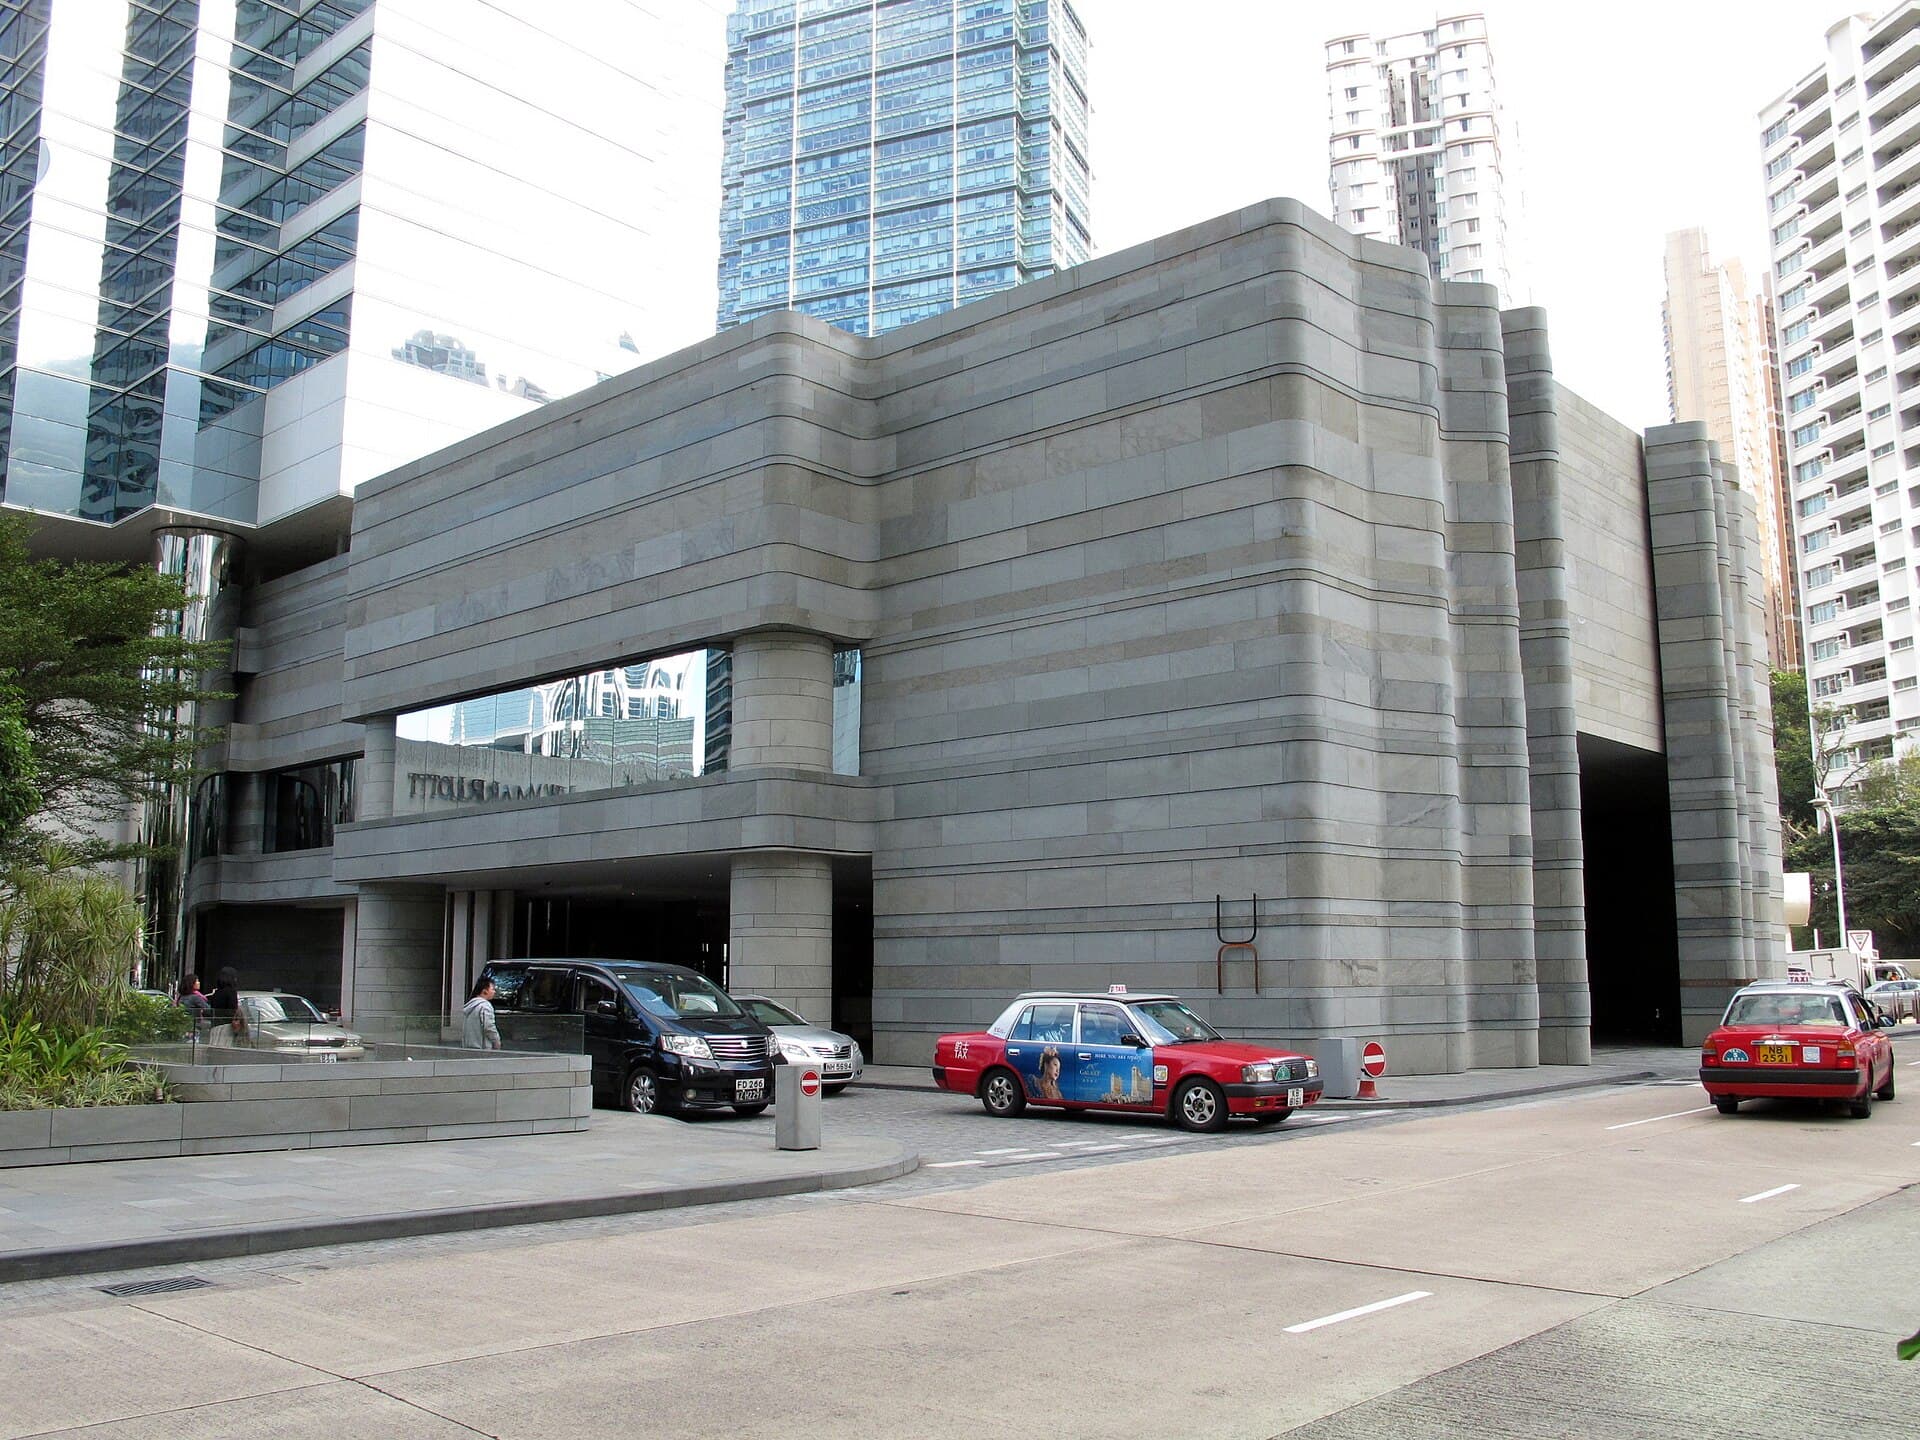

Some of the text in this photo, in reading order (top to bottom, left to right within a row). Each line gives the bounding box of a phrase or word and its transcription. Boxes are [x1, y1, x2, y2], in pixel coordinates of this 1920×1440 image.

[1769, 1046, 1783, 1054] NB
[1762, 1054, 1788, 1063] 2521
[737, 1079, 763, 1089] FD 266
